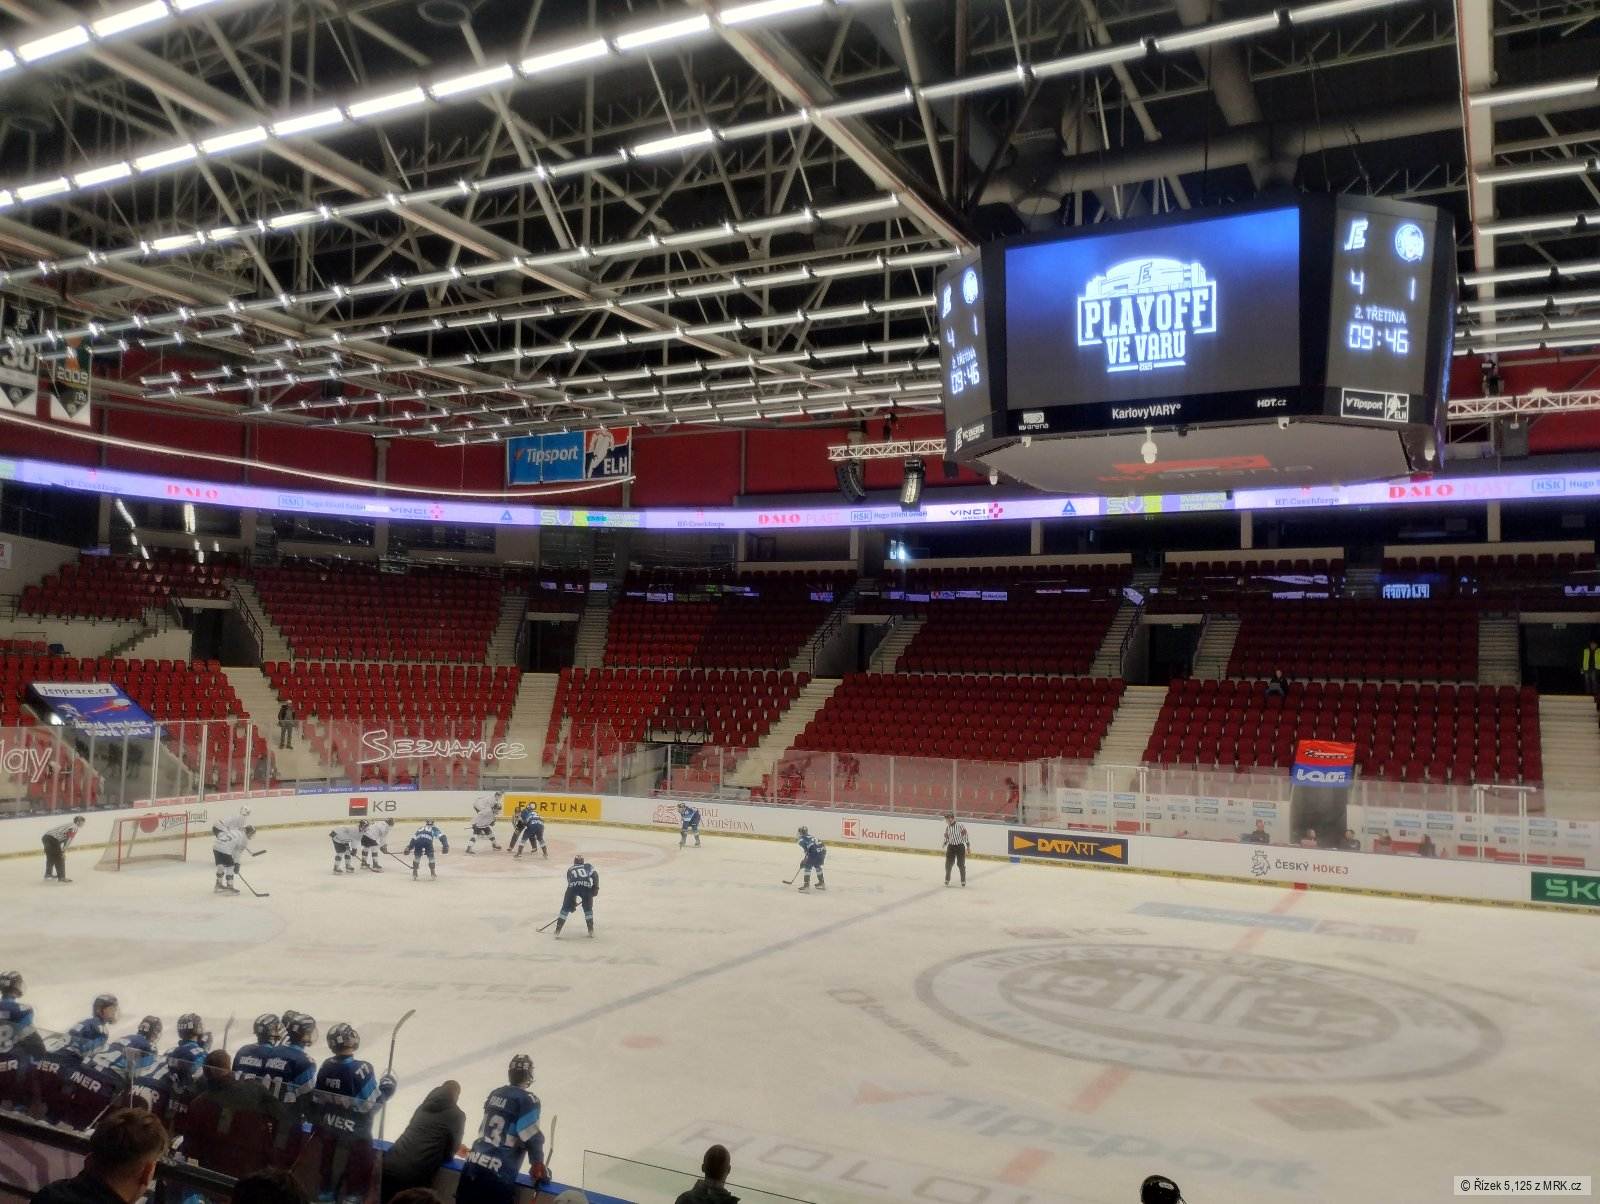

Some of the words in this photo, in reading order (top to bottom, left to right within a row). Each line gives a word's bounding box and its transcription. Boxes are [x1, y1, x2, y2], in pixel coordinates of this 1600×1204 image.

[1350, 268, 1364, 295] 4
[1409, 277, 1416, 301] 1
[1084, 288, 1209, 339] PLAYOFF
[1354, 306, 1364, 319] 2.
[1366, 305, 1407, 323] TŘETINA
[946, 328, 956, 348] 4
[1106, 336, 1131, 364] VE
[1134, 330, 1187, 362] VARU
[1349, 323, 1409, 354] 09:46
[1257, 398, 1287, 408] HDT.cz
[1354, 397, 1383, 412] Tipsport
[526, 446, 579, 465] Tipsport
[603, 457, 628, 475] ELH
[950, 508, 986, 517] VINCI
[0, 739, 53, 783] lay
[373, 800, 398, 812] KB
[518, 801, 588, 814] FORTUNA
[862, 828, 906, 841] Kaufland
[1037, 838, 1099, 856] DATART
[571, 868, 587, 878] 10
[1275, 858, 1309, 872] ČESKÝ
[1312, 862, 1349, 875] HOKEJ
[927, 1096, 1318, 1190] Tipsport
